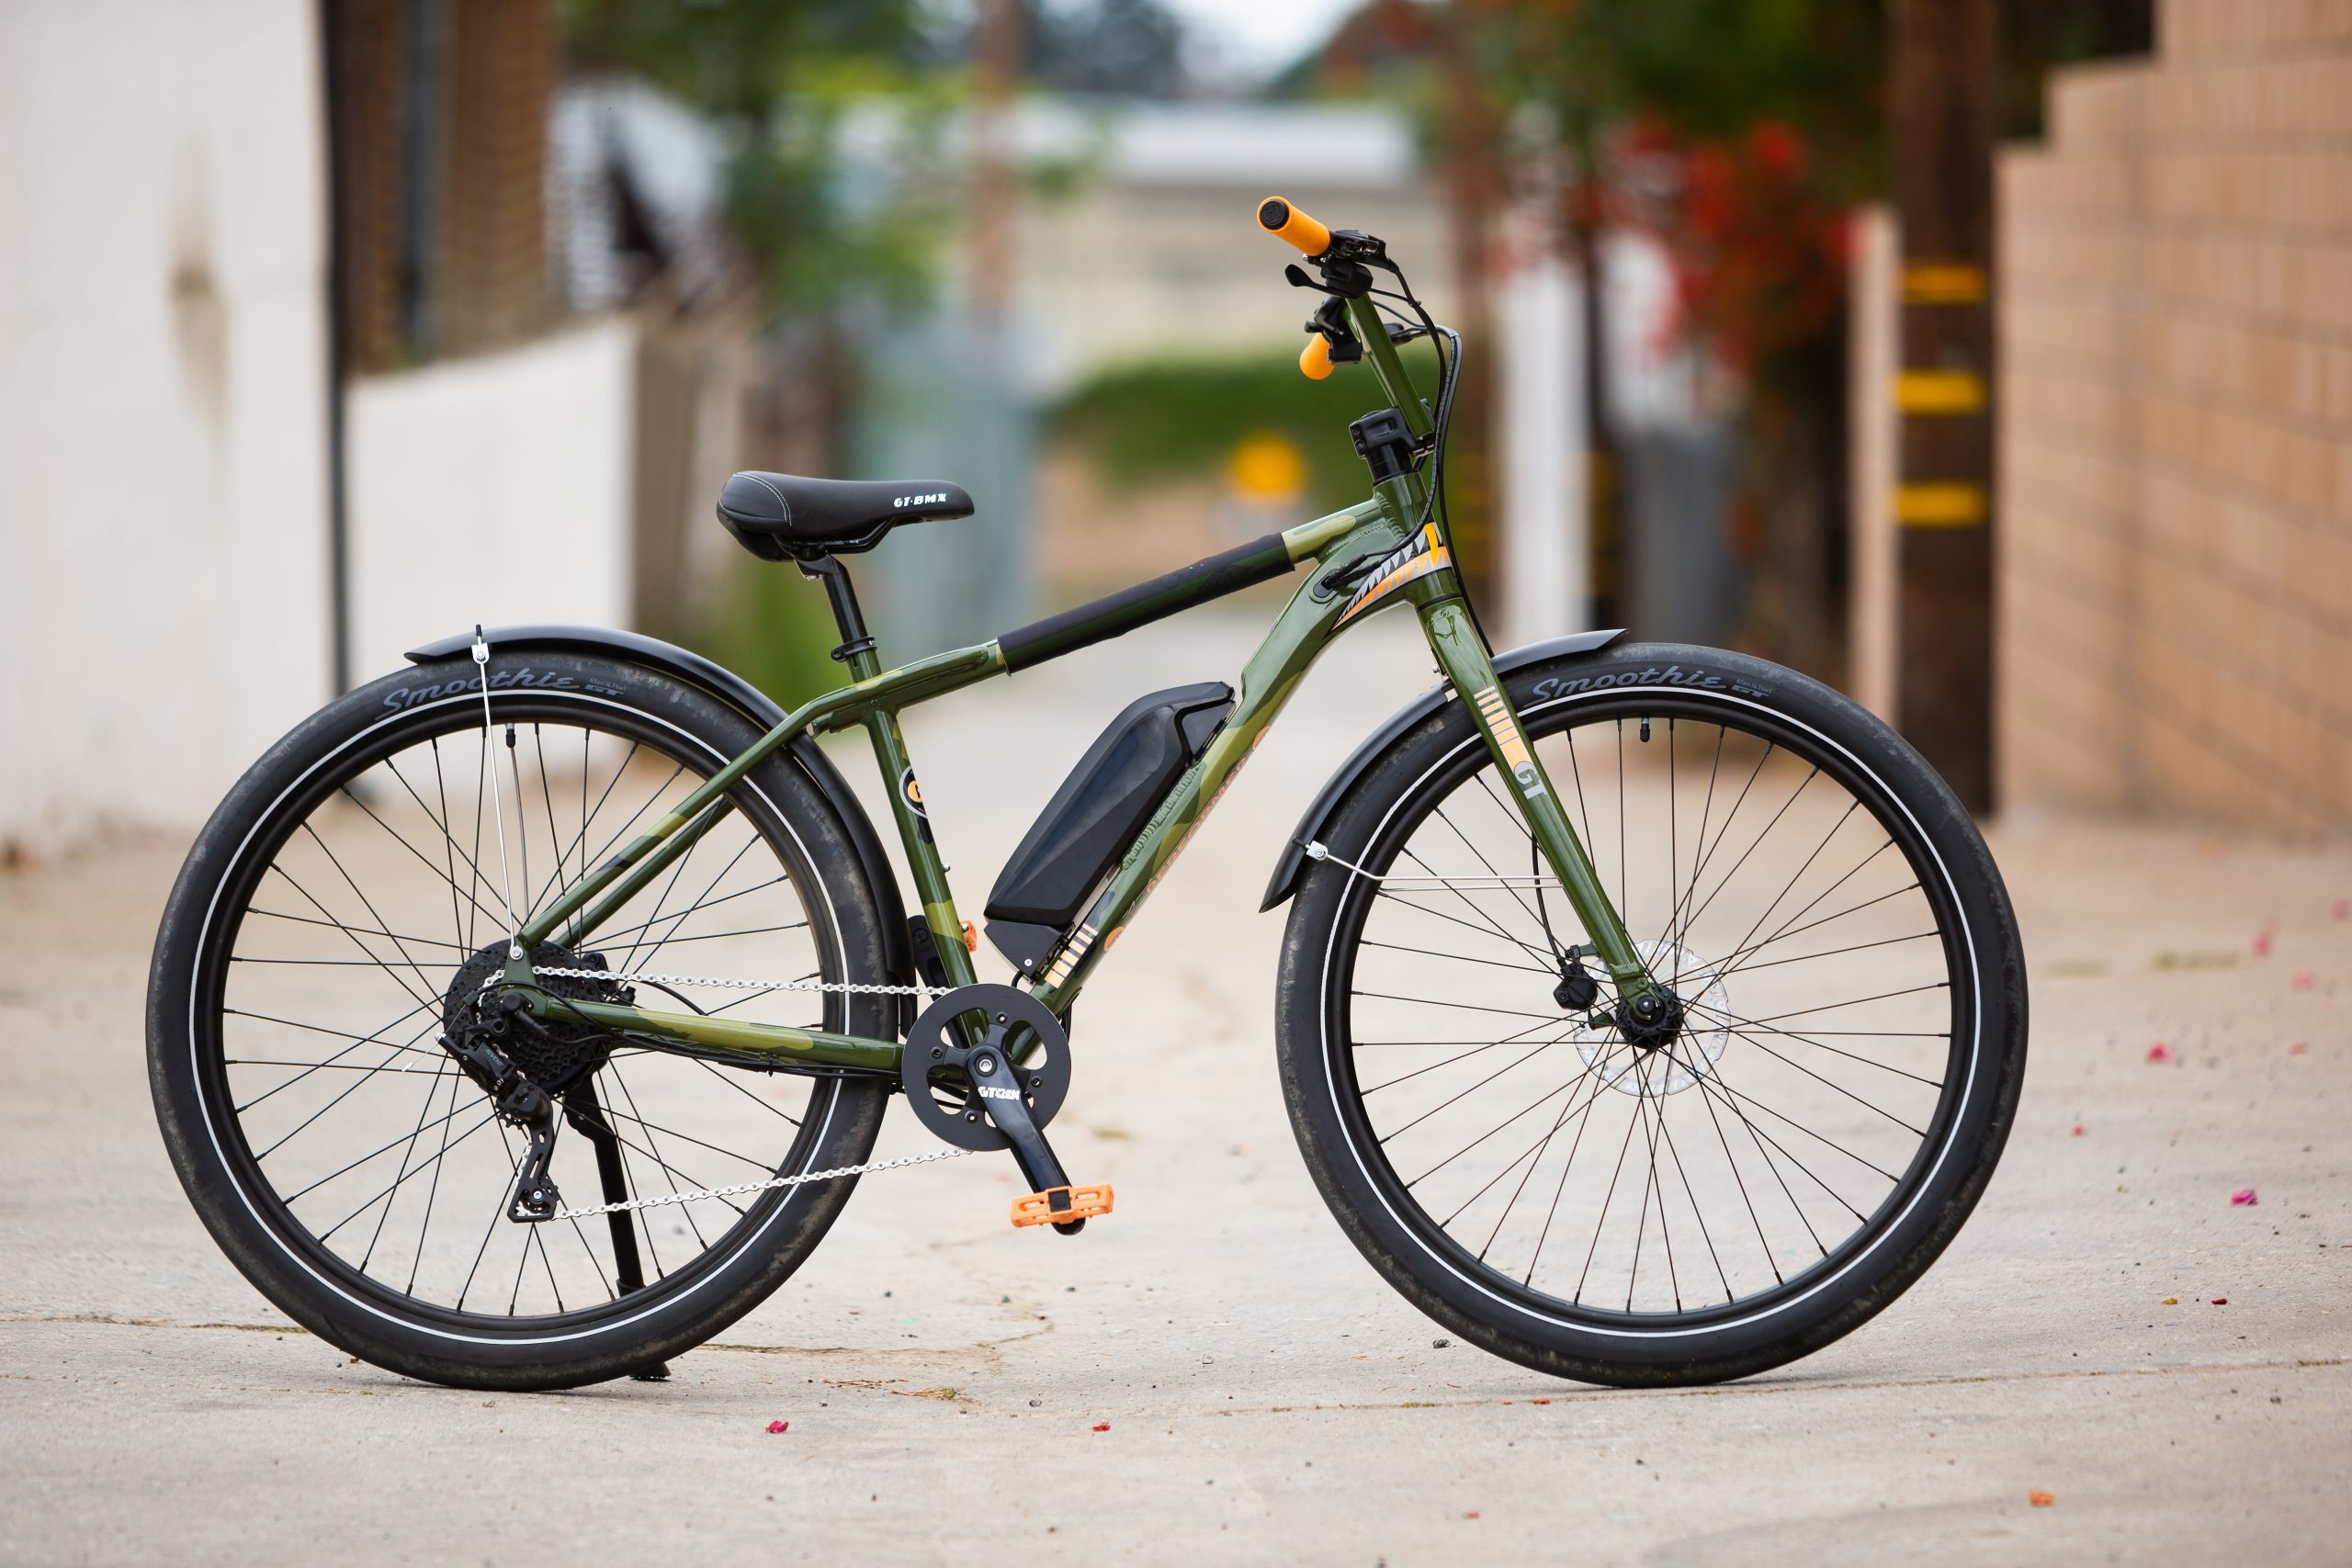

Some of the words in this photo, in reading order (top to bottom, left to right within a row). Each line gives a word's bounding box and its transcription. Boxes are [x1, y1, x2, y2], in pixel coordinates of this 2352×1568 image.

[375, 668, 581, 721] Smoothie
[1523, 665, 1726, 708] Smoothie
[1514, 761, 1547, 799] GT
